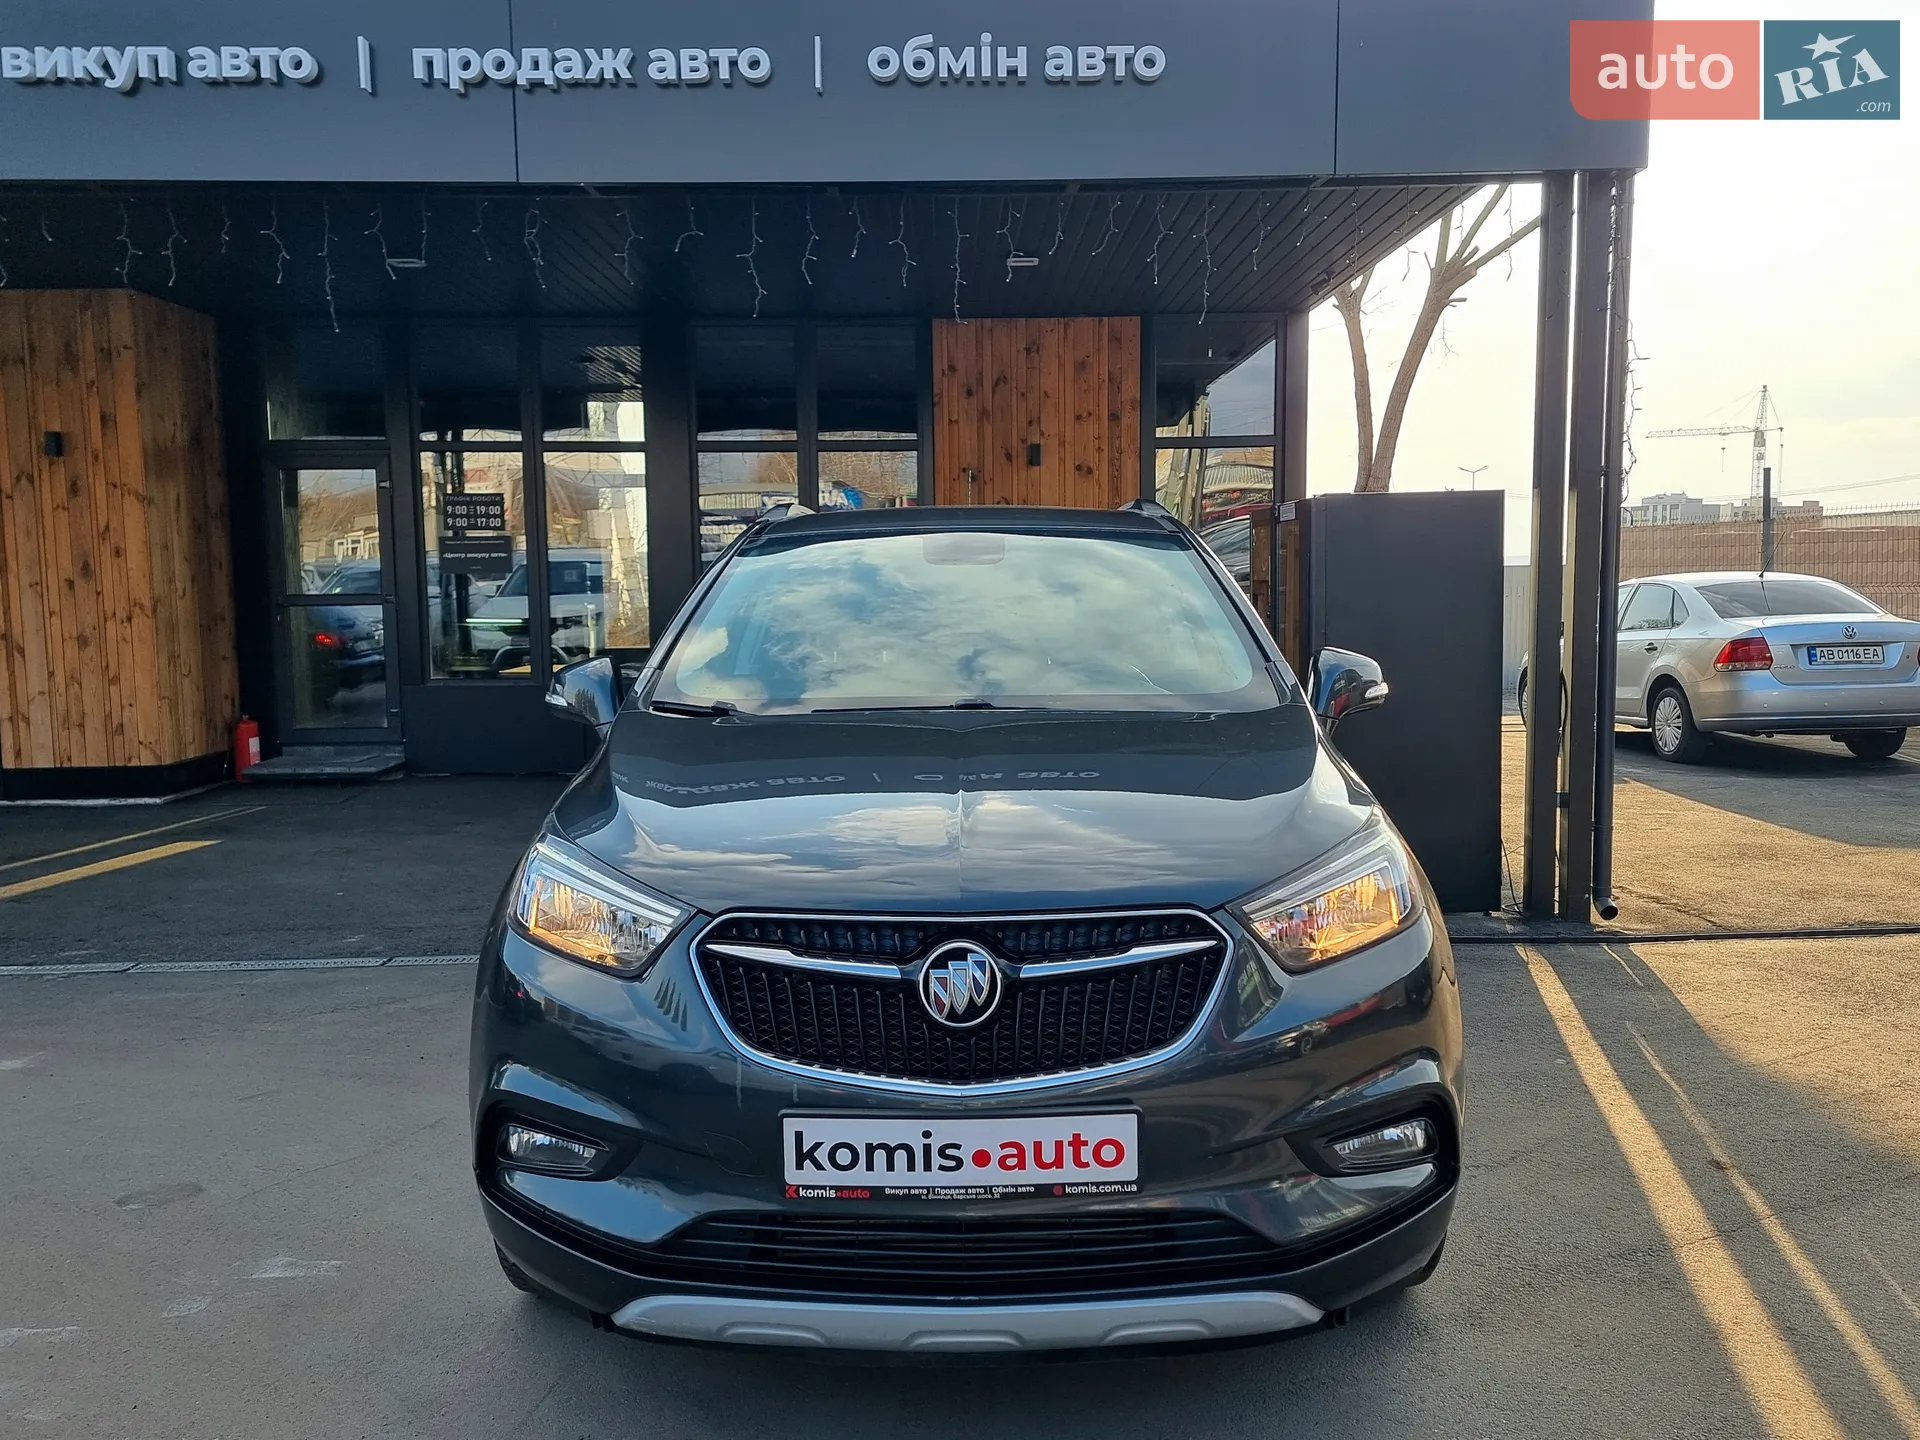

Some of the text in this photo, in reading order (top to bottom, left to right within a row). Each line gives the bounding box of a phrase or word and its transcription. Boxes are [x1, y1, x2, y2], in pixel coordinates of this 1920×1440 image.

[1, 32, 1167, 93] викуп авто продаж авто обмін авто
[446, 505, 467, 514] 9:00
[476, 505, 501, 514] 19:00
[446, 518, 468, 527] 9:00
[477, 518, 502, 527] 17:00
[1819, 649, 1835, 661] AB
[1837, 649, 1861, 660] 0116
[1863, 648, 1880, 660] EA
[885, 1187, 909, 1195] Викуп
[935, 1187, 967, 1196] Продаж
[992, 1186, 1016, 1194] Обмін
[1065, 1183, 1138, 1195] komis.com.ua
